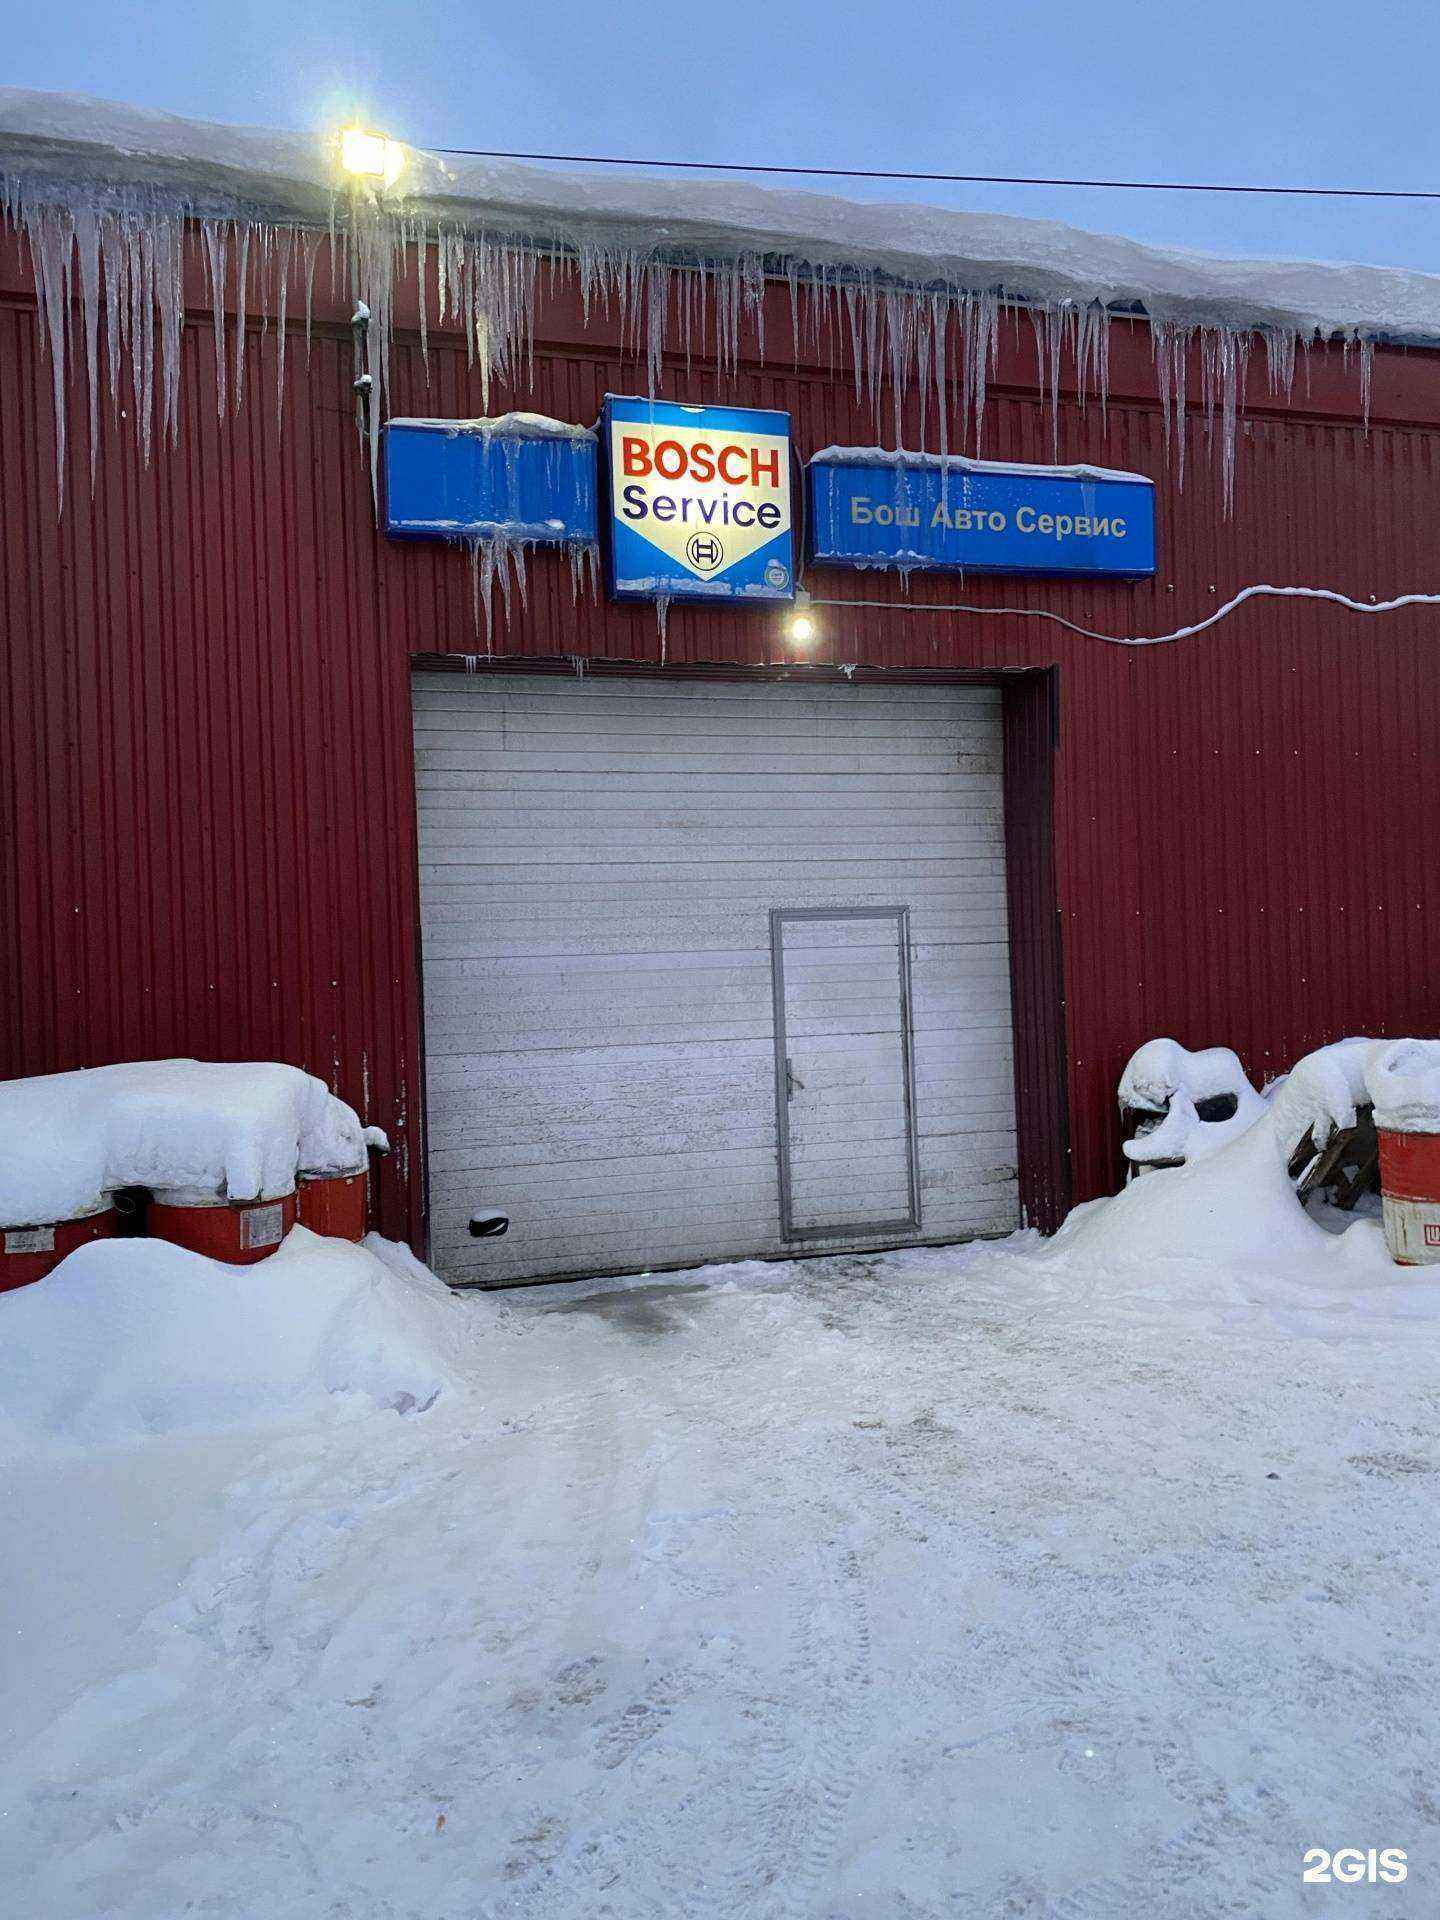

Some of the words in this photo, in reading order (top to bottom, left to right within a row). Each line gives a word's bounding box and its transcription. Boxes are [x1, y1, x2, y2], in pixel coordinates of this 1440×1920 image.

[622, 436, 780, 488] BOSCH
[622, 484, 782, 529] Service
[850, 496, 921, 527] Бош
[930, 501, 1007, 532] Авто
[1015, 506, 1128, 541] Сервис
